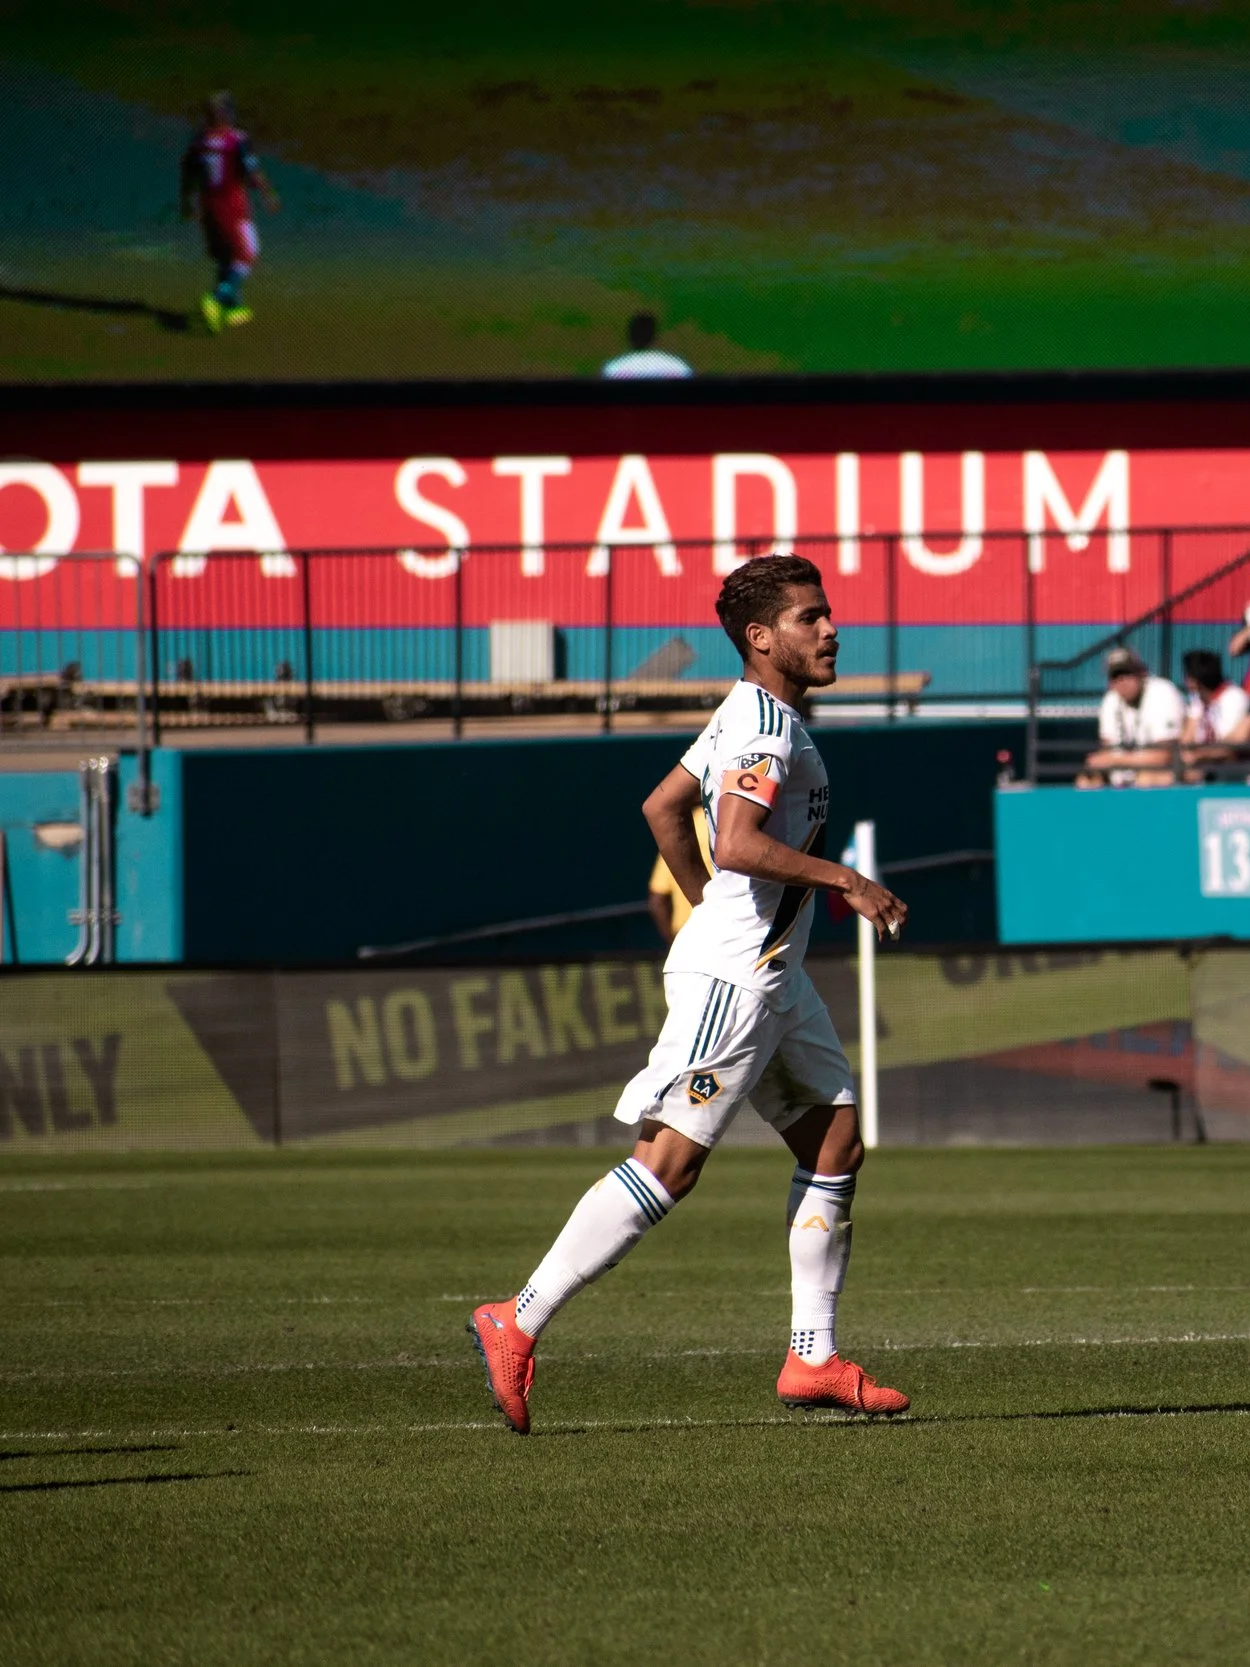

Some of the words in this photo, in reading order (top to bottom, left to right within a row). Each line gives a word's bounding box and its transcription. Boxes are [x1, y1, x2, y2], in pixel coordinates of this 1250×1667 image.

[395, 451, 1131, 579] STADIUM
[737, 773, 758, 791] C
[326, 989, 438, 1090] NO
[692, 1079, 710, 1098] LA
